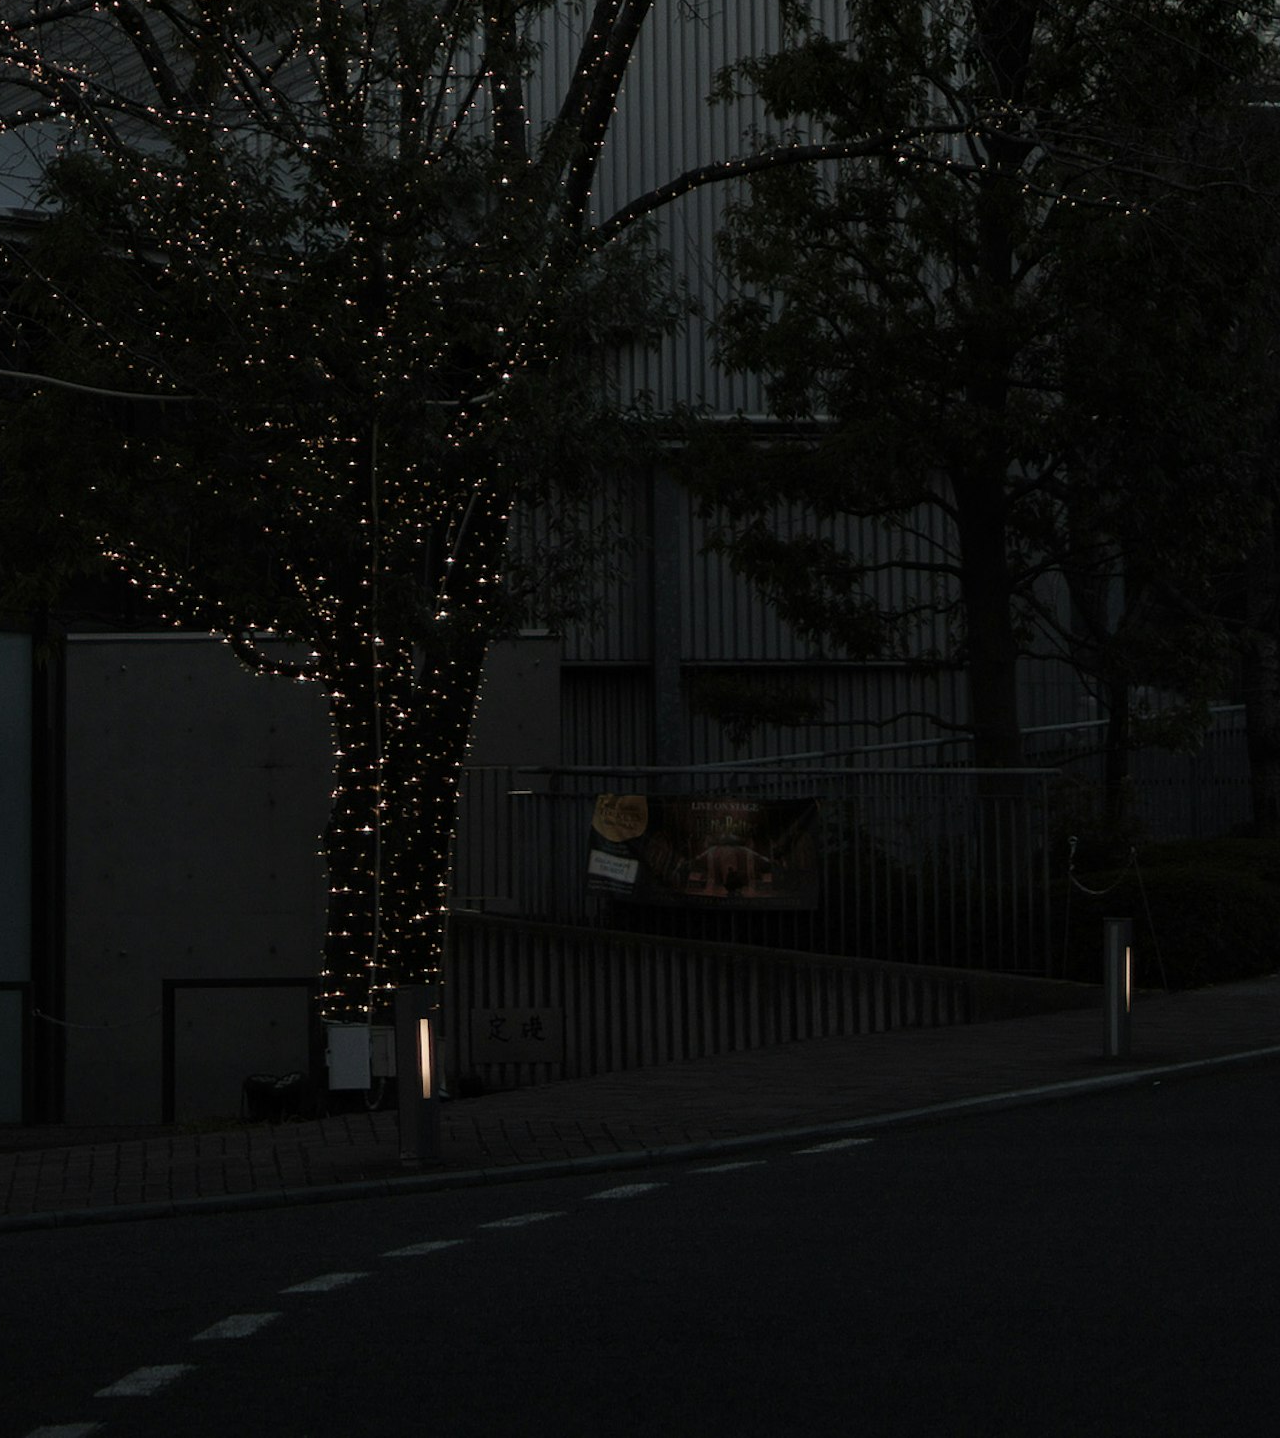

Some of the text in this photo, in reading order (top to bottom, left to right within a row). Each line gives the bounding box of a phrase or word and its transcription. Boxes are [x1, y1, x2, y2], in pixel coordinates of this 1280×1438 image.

[692, 802, 759, 812] LIVE ON STAGE
